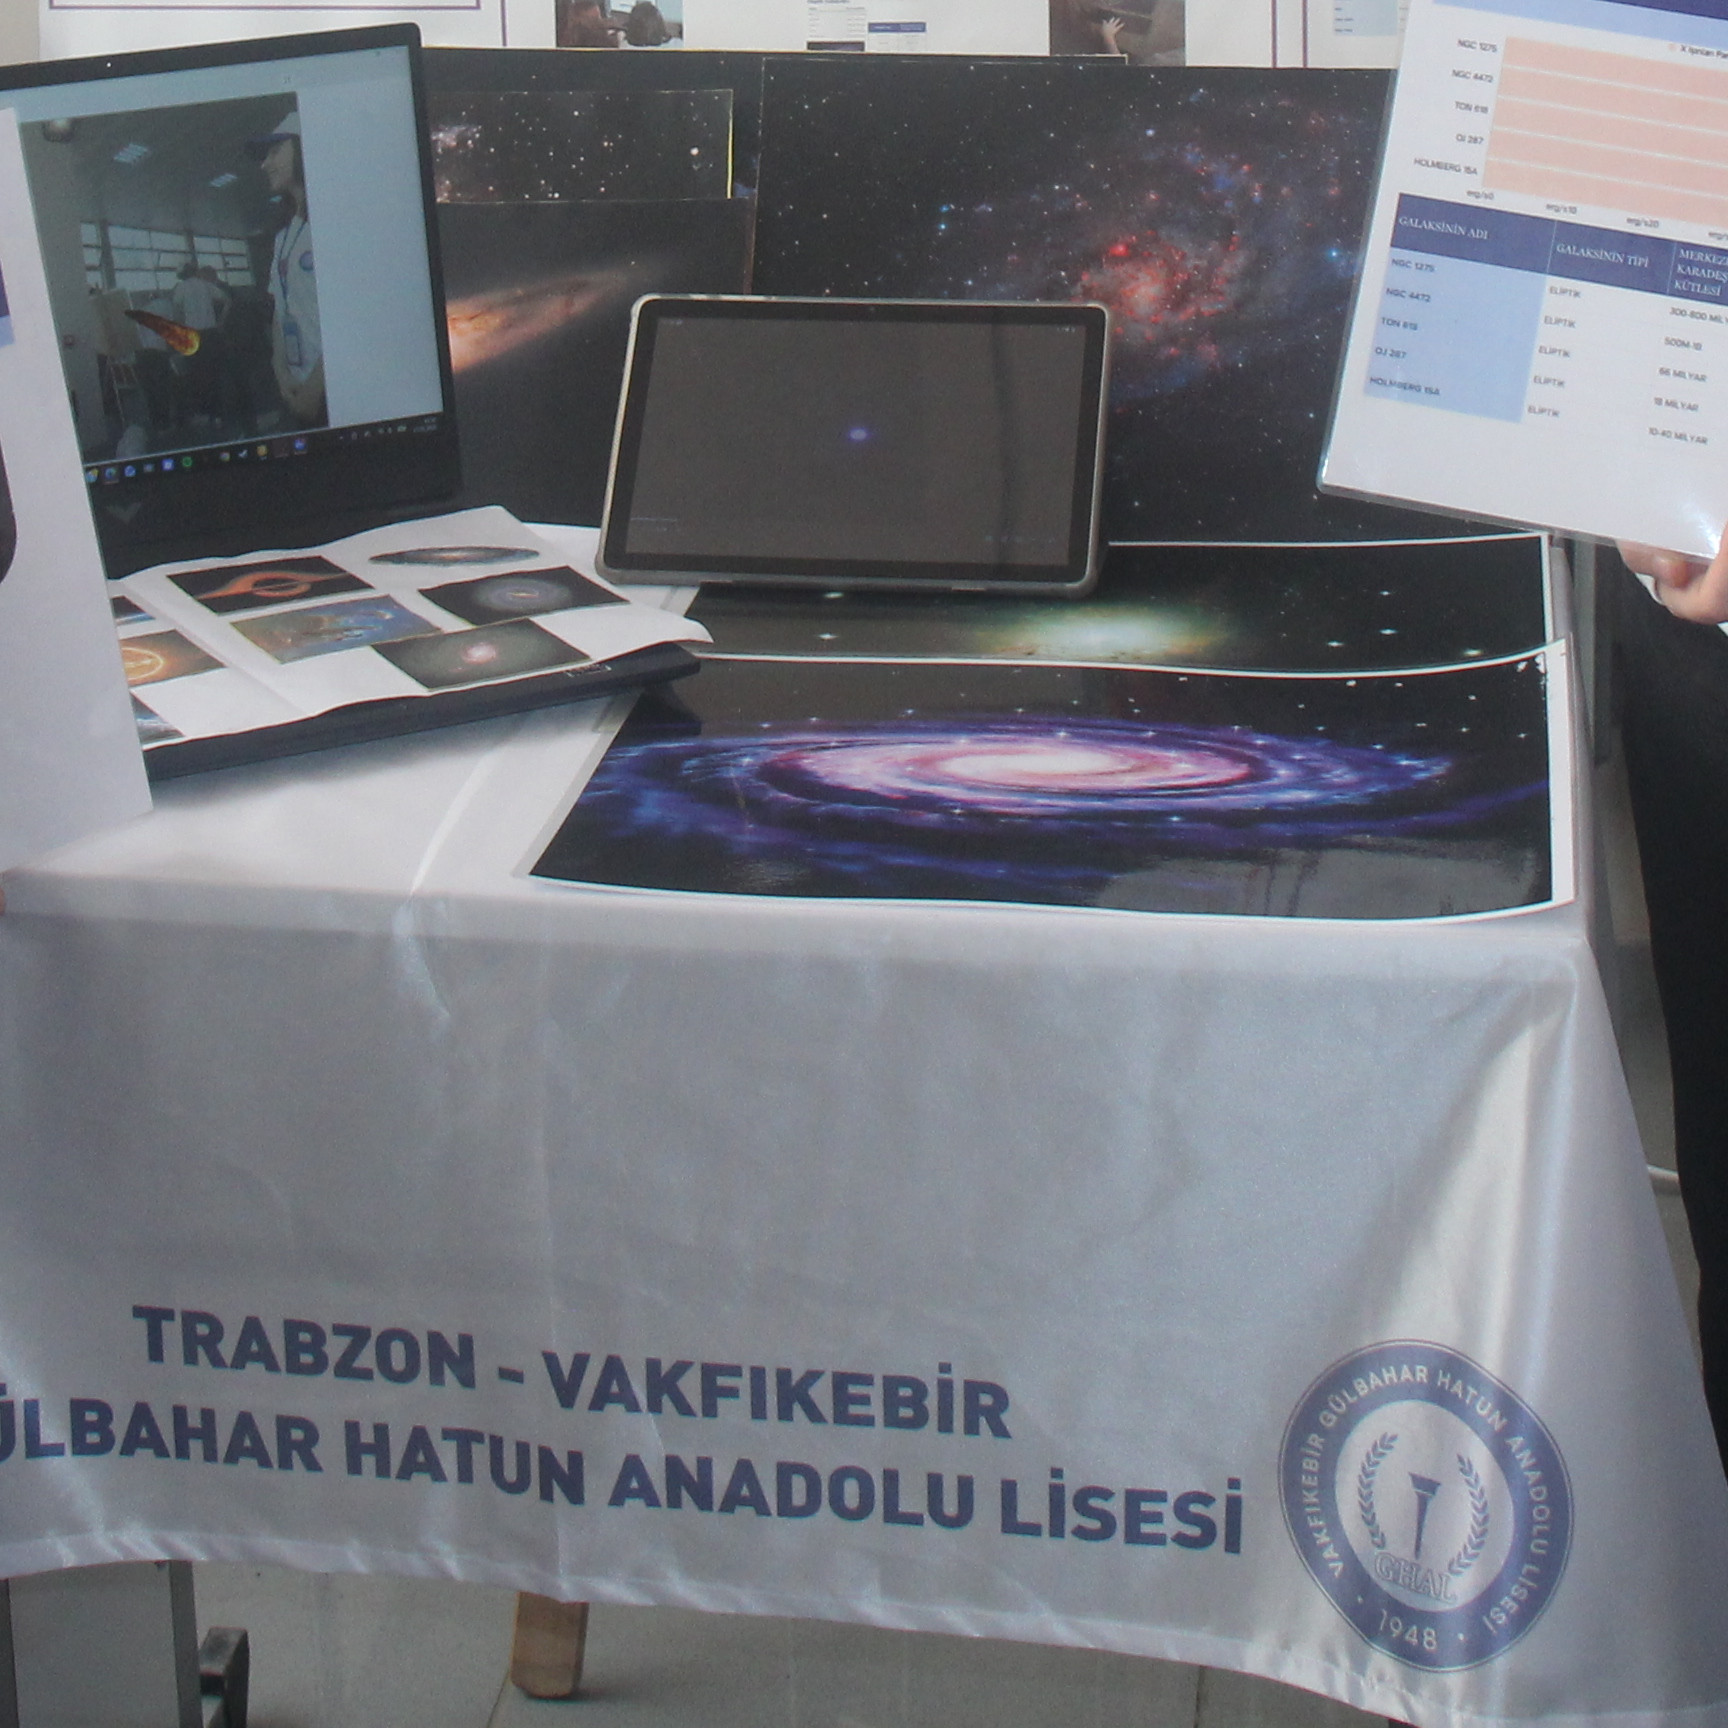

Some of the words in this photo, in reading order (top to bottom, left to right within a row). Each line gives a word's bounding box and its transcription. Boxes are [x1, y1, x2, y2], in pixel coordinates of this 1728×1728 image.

[1467, 229, 1488, 240] ADI
[132, 1305, 475, 1389] TRABZON
[542, 1351, 1012, 1439] VAKFIKEBİR
[1320, 1364, 1428, 1428] GÜLBAHAR
[1439, 1370, 1508, 1431] HATUN
[345, 1420, 584, 1505] HATUN
[608, 1454, 974, 1529] ANADOLU
[999, 1466, 1247, 1558] LİSESİ
[1506, 1436, 1551, 1554] ANADOLU
[1380, 1609, 1437, 1650] 1948
[1483, 1564, 1540, 1633] LİSESİ
